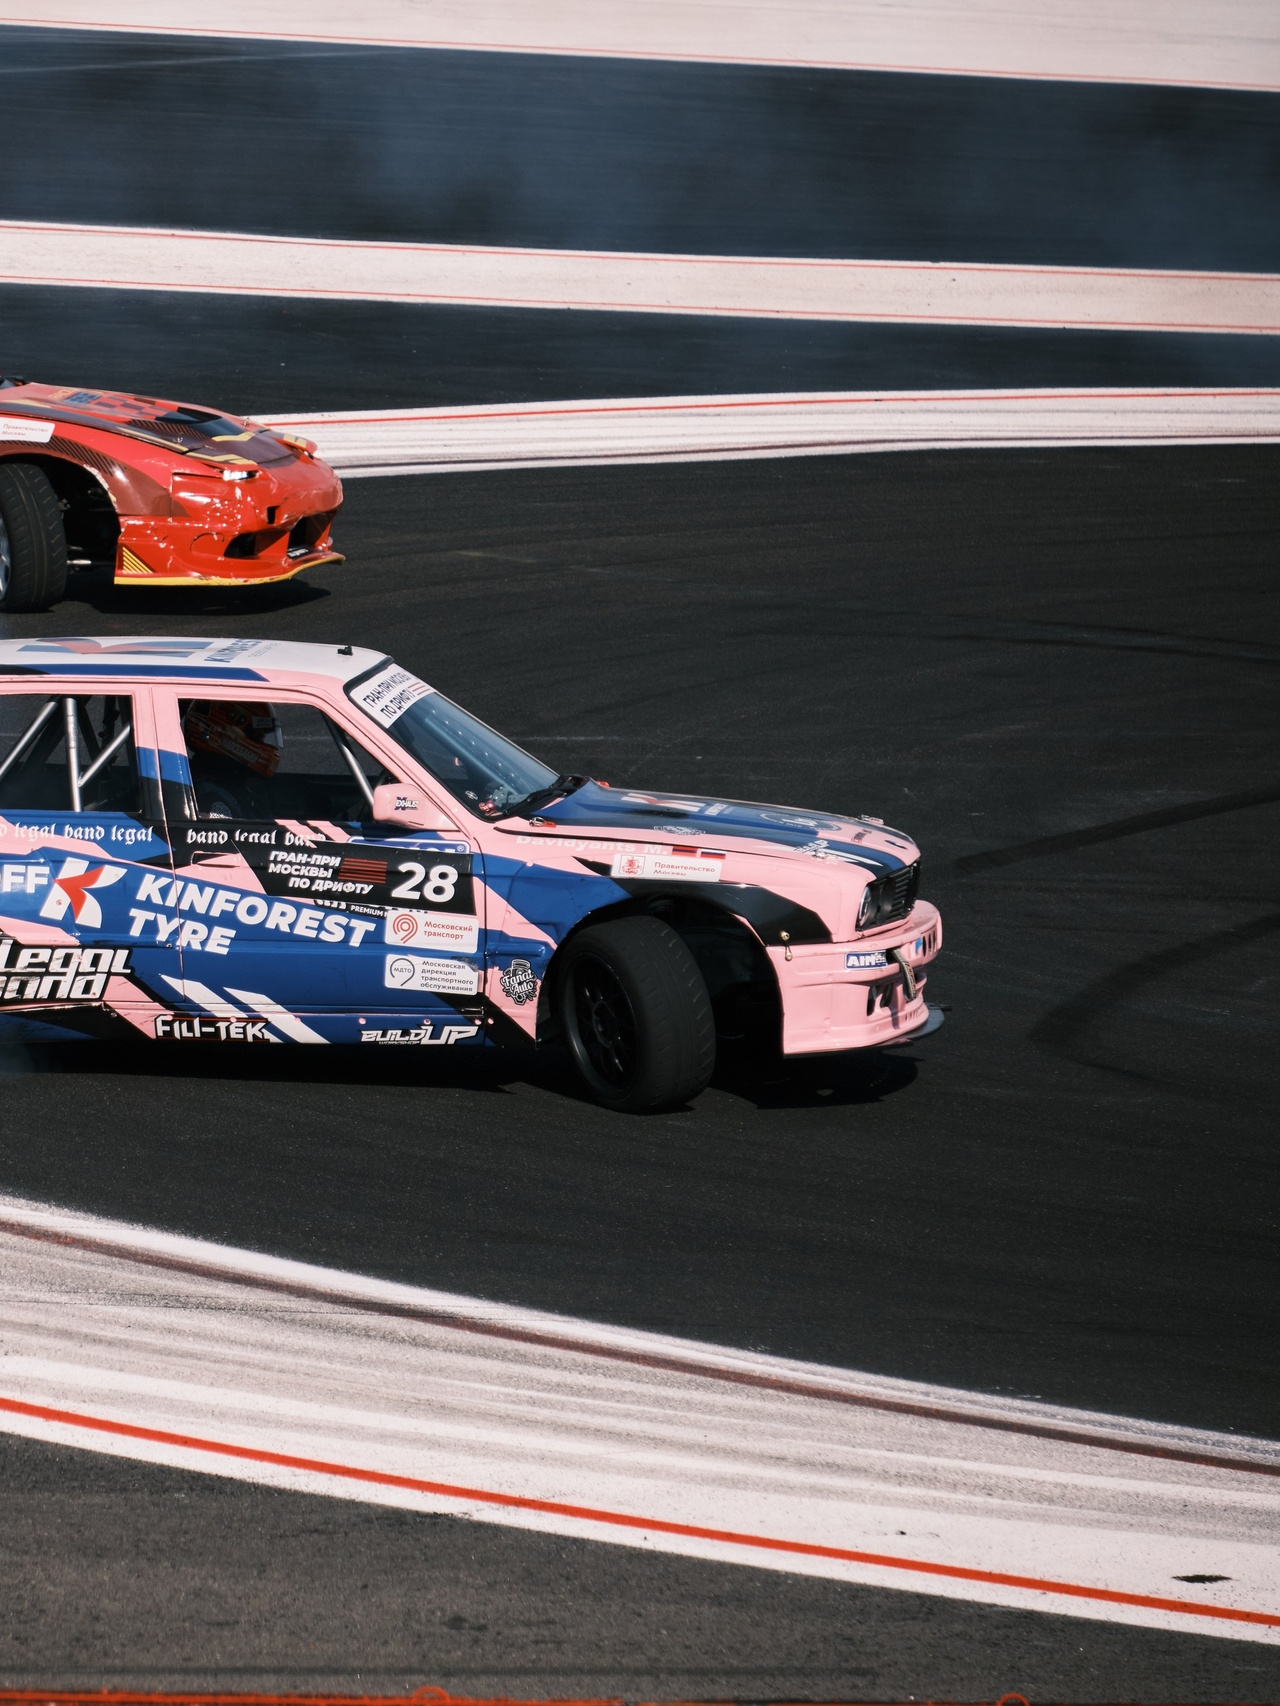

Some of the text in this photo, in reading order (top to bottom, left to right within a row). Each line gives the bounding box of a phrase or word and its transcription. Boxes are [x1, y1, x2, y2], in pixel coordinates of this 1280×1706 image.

[380, 704, 397, 719] ПО
[14, 823, 57, 842] legal
[64, 824, 105, 841] band
[111, 825, 153, 845] legal
[186, 828, 229, 844] band
[516, 835, 668, 855] Davidyants M.
[269, 850, 341, 867] ГРАН-ПРИ
[268, 863, 332, 878] МОСКВЫ
[653, 869, 687, 877] Москвы
[654, 861, 716, 873] Правительство
[288, 876, 374, 895] ПО ДРИФТУ
[391, 862, 459, 902] 28
[136, 873, 376, 947] KINFOREST
[350, 904, 384, 916] PREMIUM
[128, 909, 236, 955] TYRE
[424, 920, 473, 932] Московский
[423, 930, 464, 940] транспорт
[421, 960, 466, 970] Московская
[421, 968, 457, 977] дирекция
[421, 975, 474, 985] транспортного
[503, 969, 533, 987] Fanat
[420, 982, 473, 993] обслуживания
[511, 981, 534, 996] Auto
